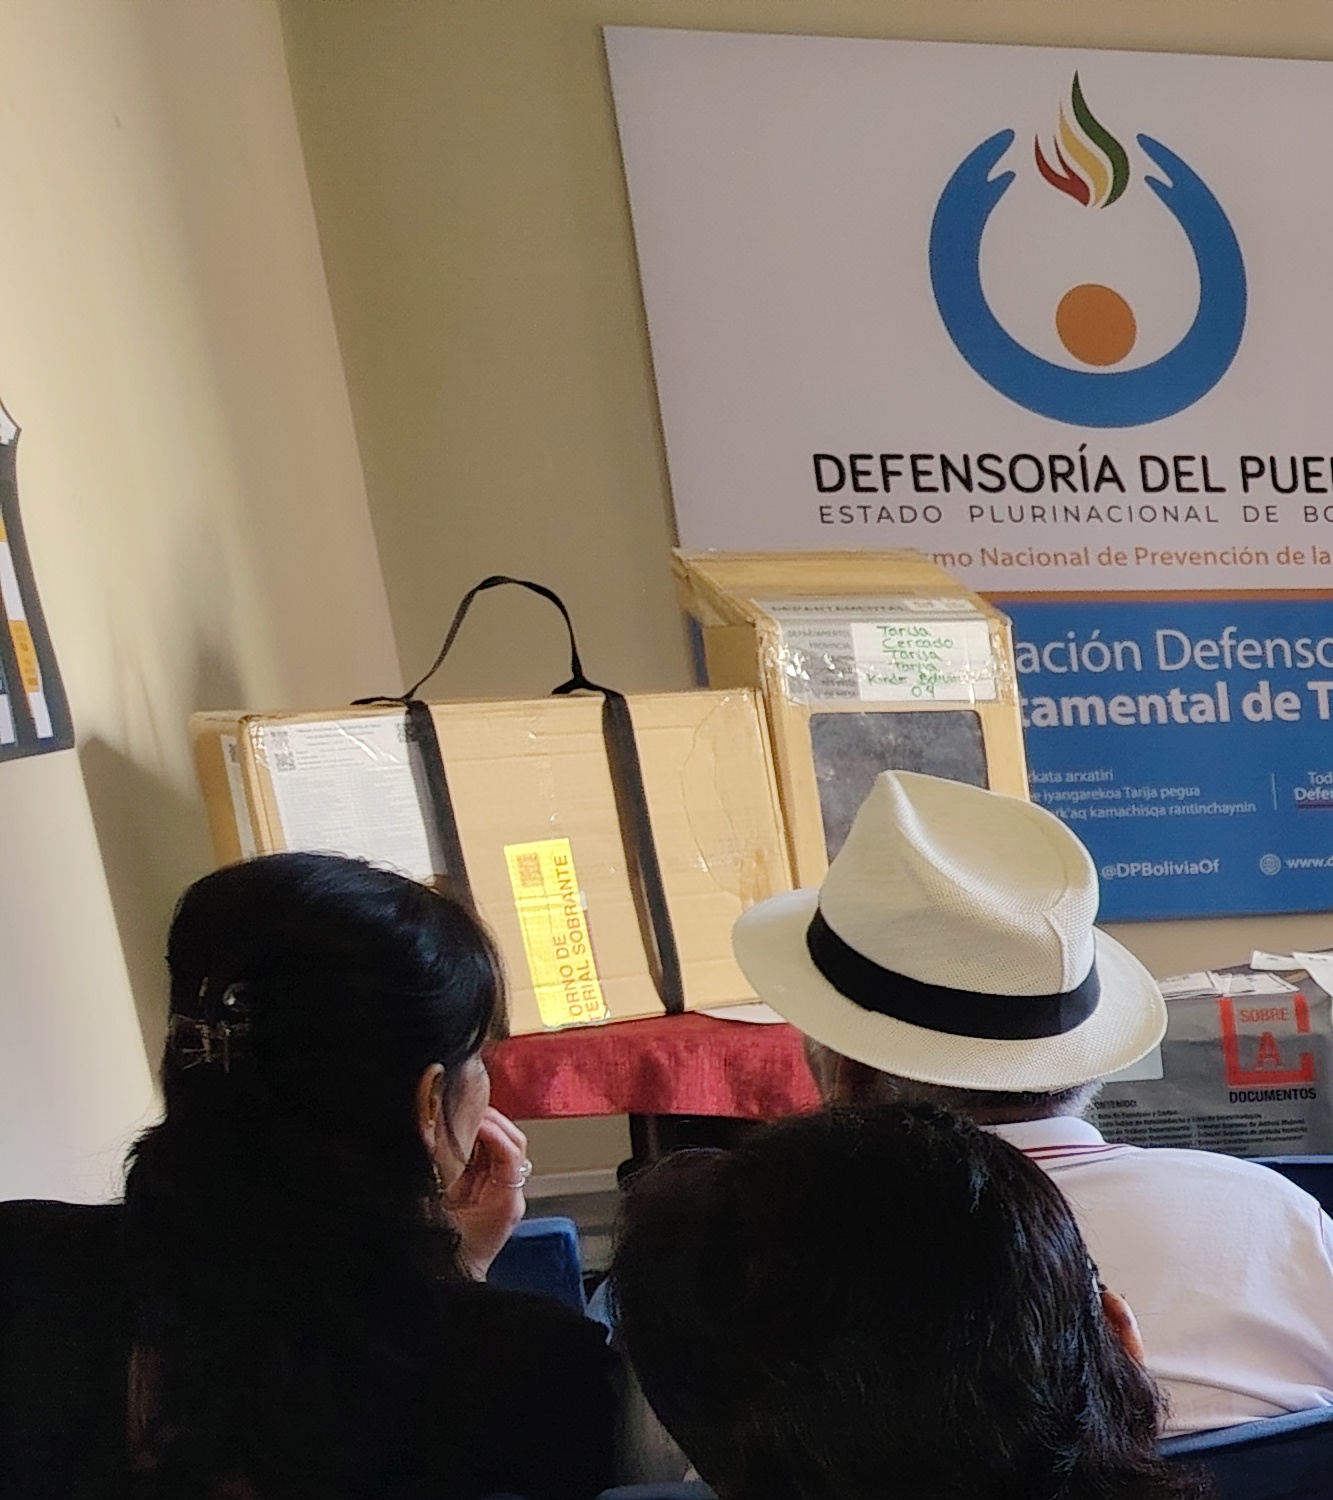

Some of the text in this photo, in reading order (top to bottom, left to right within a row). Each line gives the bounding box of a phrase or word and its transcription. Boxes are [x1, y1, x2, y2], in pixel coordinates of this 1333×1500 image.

[813, 443, 1126, 493] DEFENSORÍA
[1140, 455, 1226, 493] DEL
[819, 505, 942, 524] ESTADO
[968, 504, 1219, 524] PLURINACIONAL
[1243, 505, 1279, 523] DE
[980, 547, 1089, 567] Nacional
[1098, 547, 1128, 566] de
[1135, 546, 1269, 566] Prevención
[1276, 546, 1305, 565] de
[1312, 545, 1332, 565] la
[877, 625, 931, 637] Tarija
[882, 638, 953, 649] Cercado
[1016, 629, 1142, 673] ación
[1021, 681, 1231, 728] tamental
[1242, 680, 1301, 722] de
[1030, 769, 1062, 783] kata
[1123, 785, 1157, 801] Tarija
[553, 854, 600, 1018] ERIAL SOBRANTE
[553, 935, 584, 1017] ORNO DE
[1240, 1008, 1290, 1023] SOBRE
[1257, 1032, 1281, 1070] A
[1229, 1088, 1317, 1104] DOCUMENTOS
